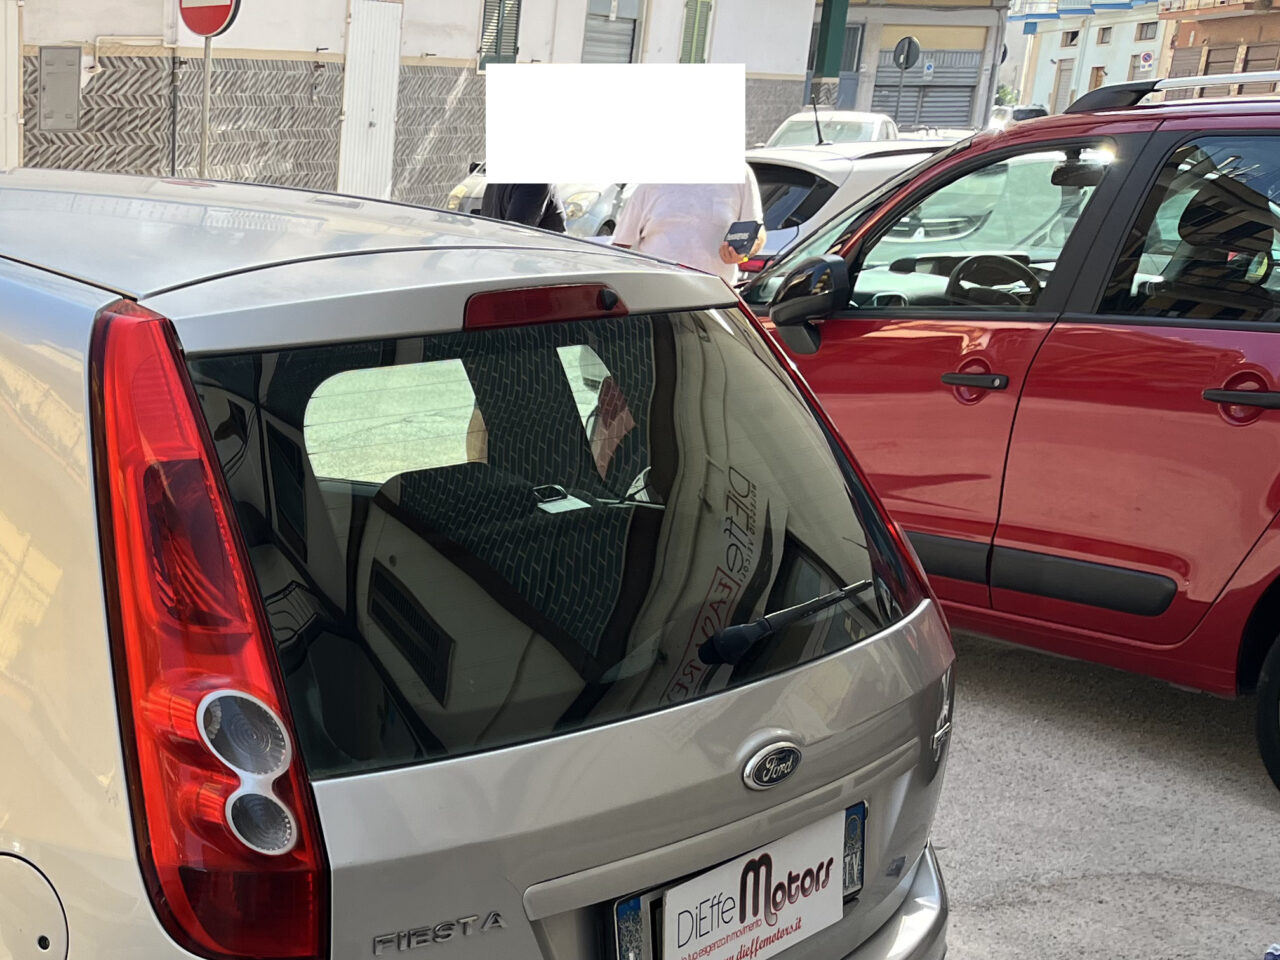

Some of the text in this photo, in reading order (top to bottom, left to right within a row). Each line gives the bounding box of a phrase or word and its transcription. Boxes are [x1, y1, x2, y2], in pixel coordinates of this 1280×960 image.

[762, 754, 794, 782] Ford
[677, 853, 834, 948] DiEffe Motors
[373, 910, 508, 956] FIESTA
